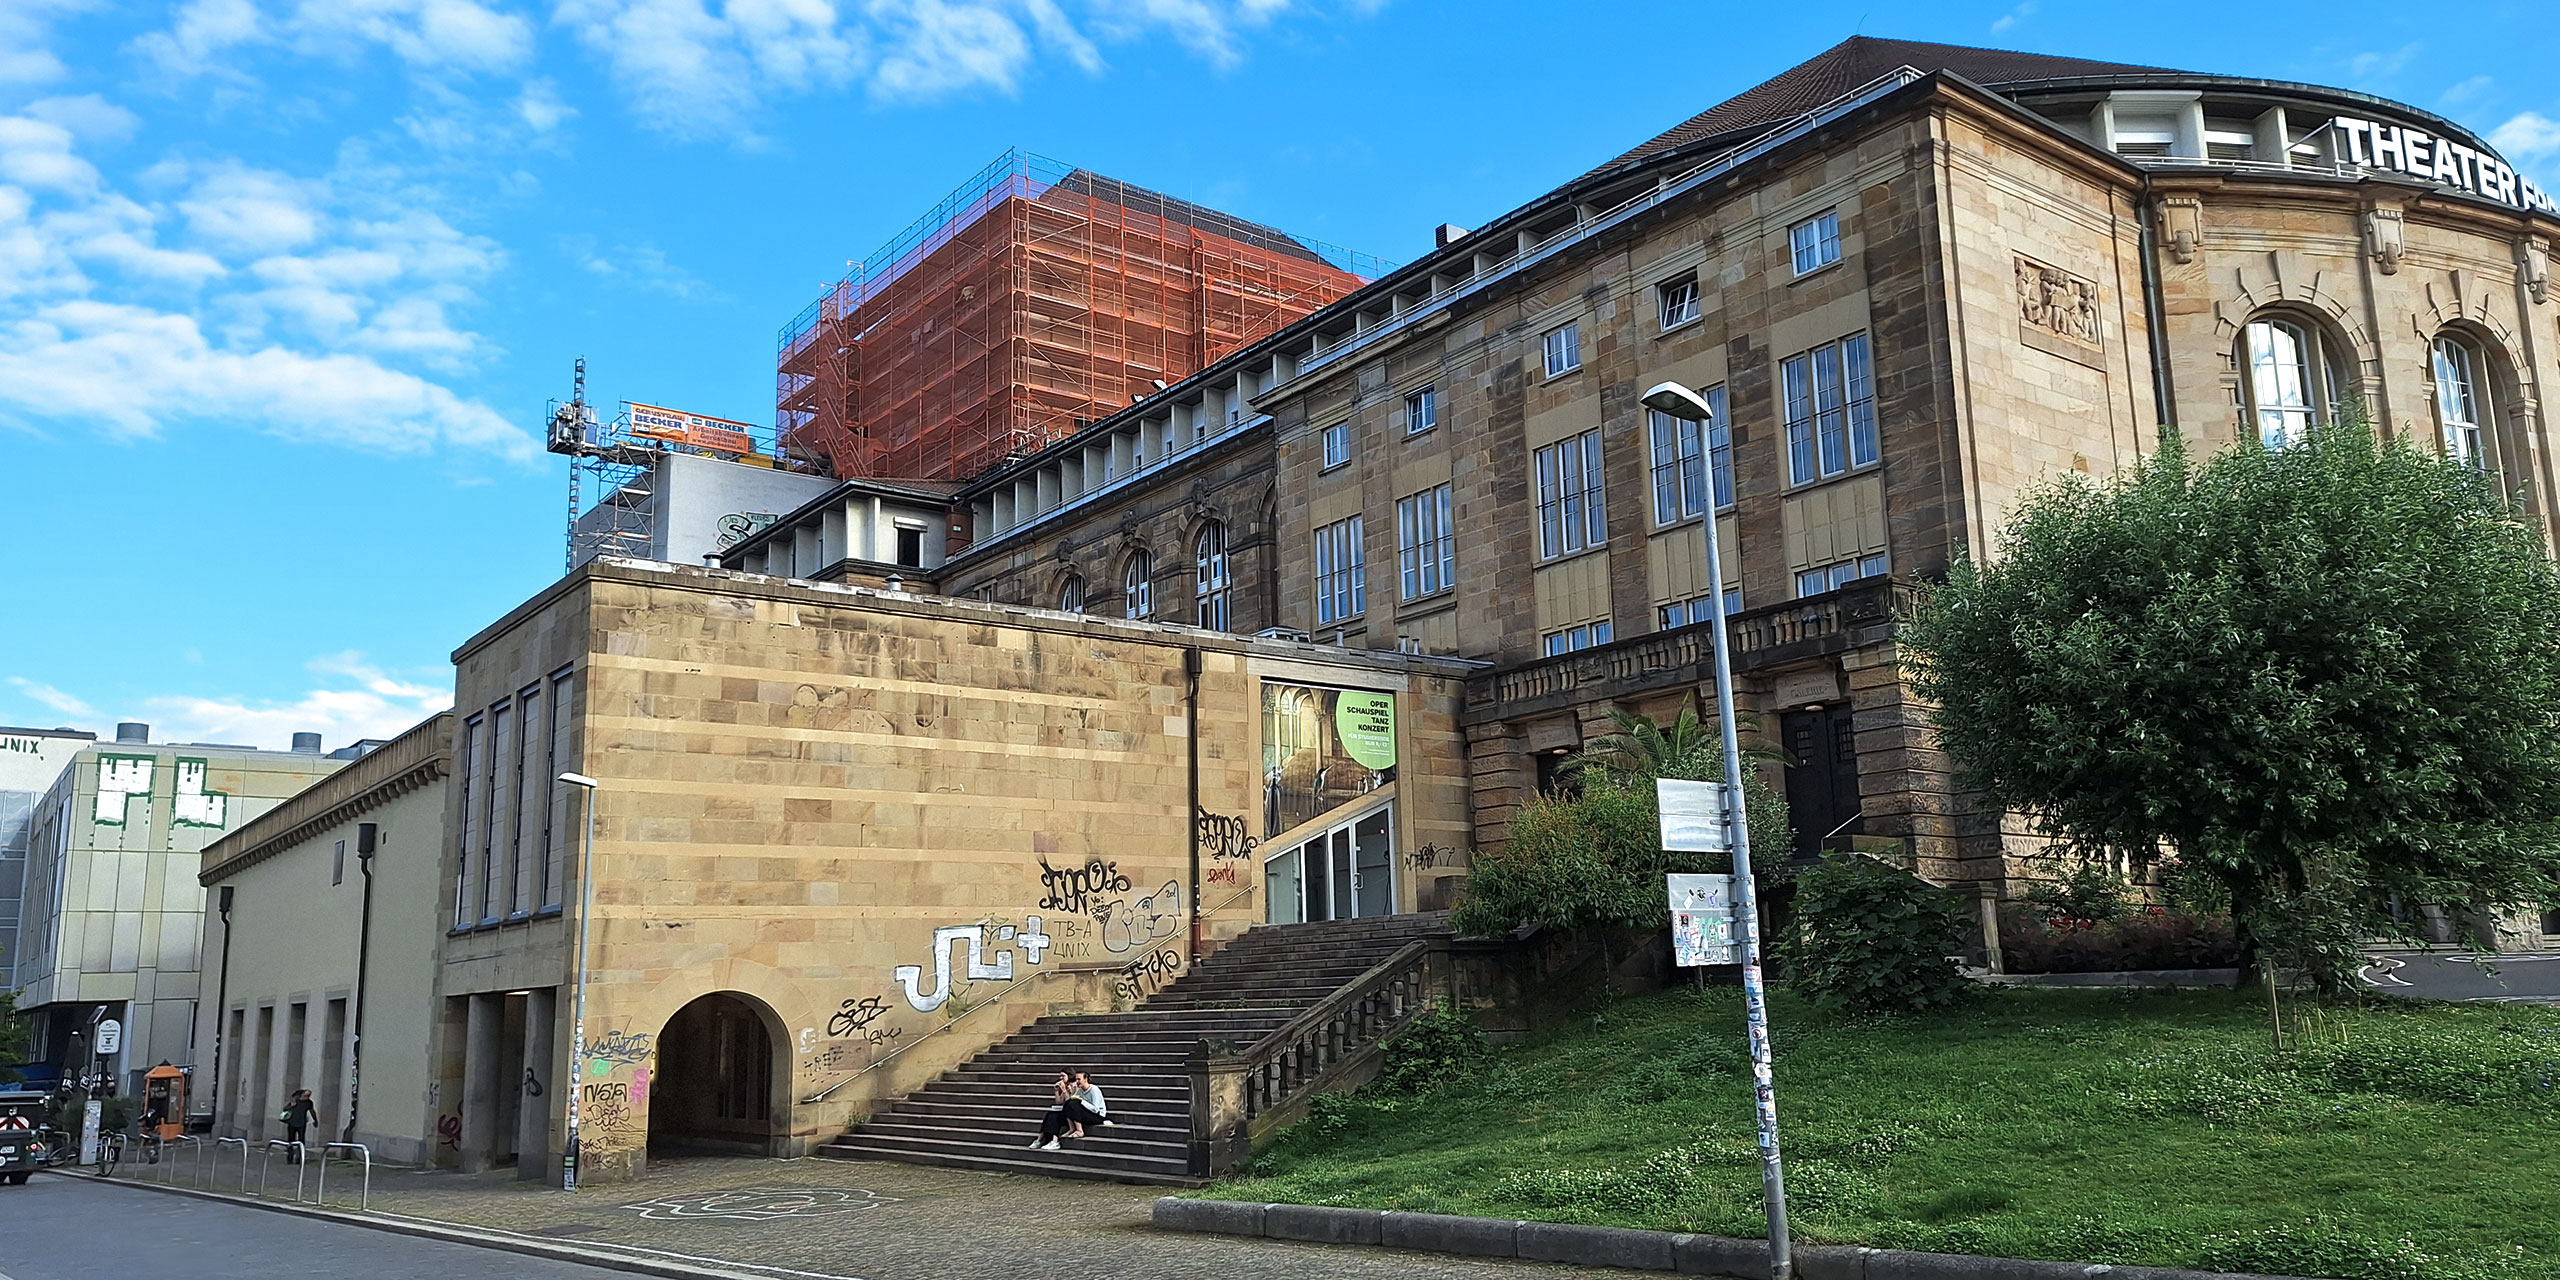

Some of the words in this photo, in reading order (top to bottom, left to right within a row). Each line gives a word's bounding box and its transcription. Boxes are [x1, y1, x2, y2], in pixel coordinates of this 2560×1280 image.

[2334, 115, 2519, 207] THEATER
[635, 415, 682, 429] BECKER
[704, 420, 745, 433] BECKER
[1370, 700, 1389, 708] OPER
[1347, 706, 1389, 716] SCHAUSPIEL
[1371, 717, 1389, 725] TANZ
[1358, 724, 1389, 733] KONZERT
[1053, 920, 1092, 939] TB-A
